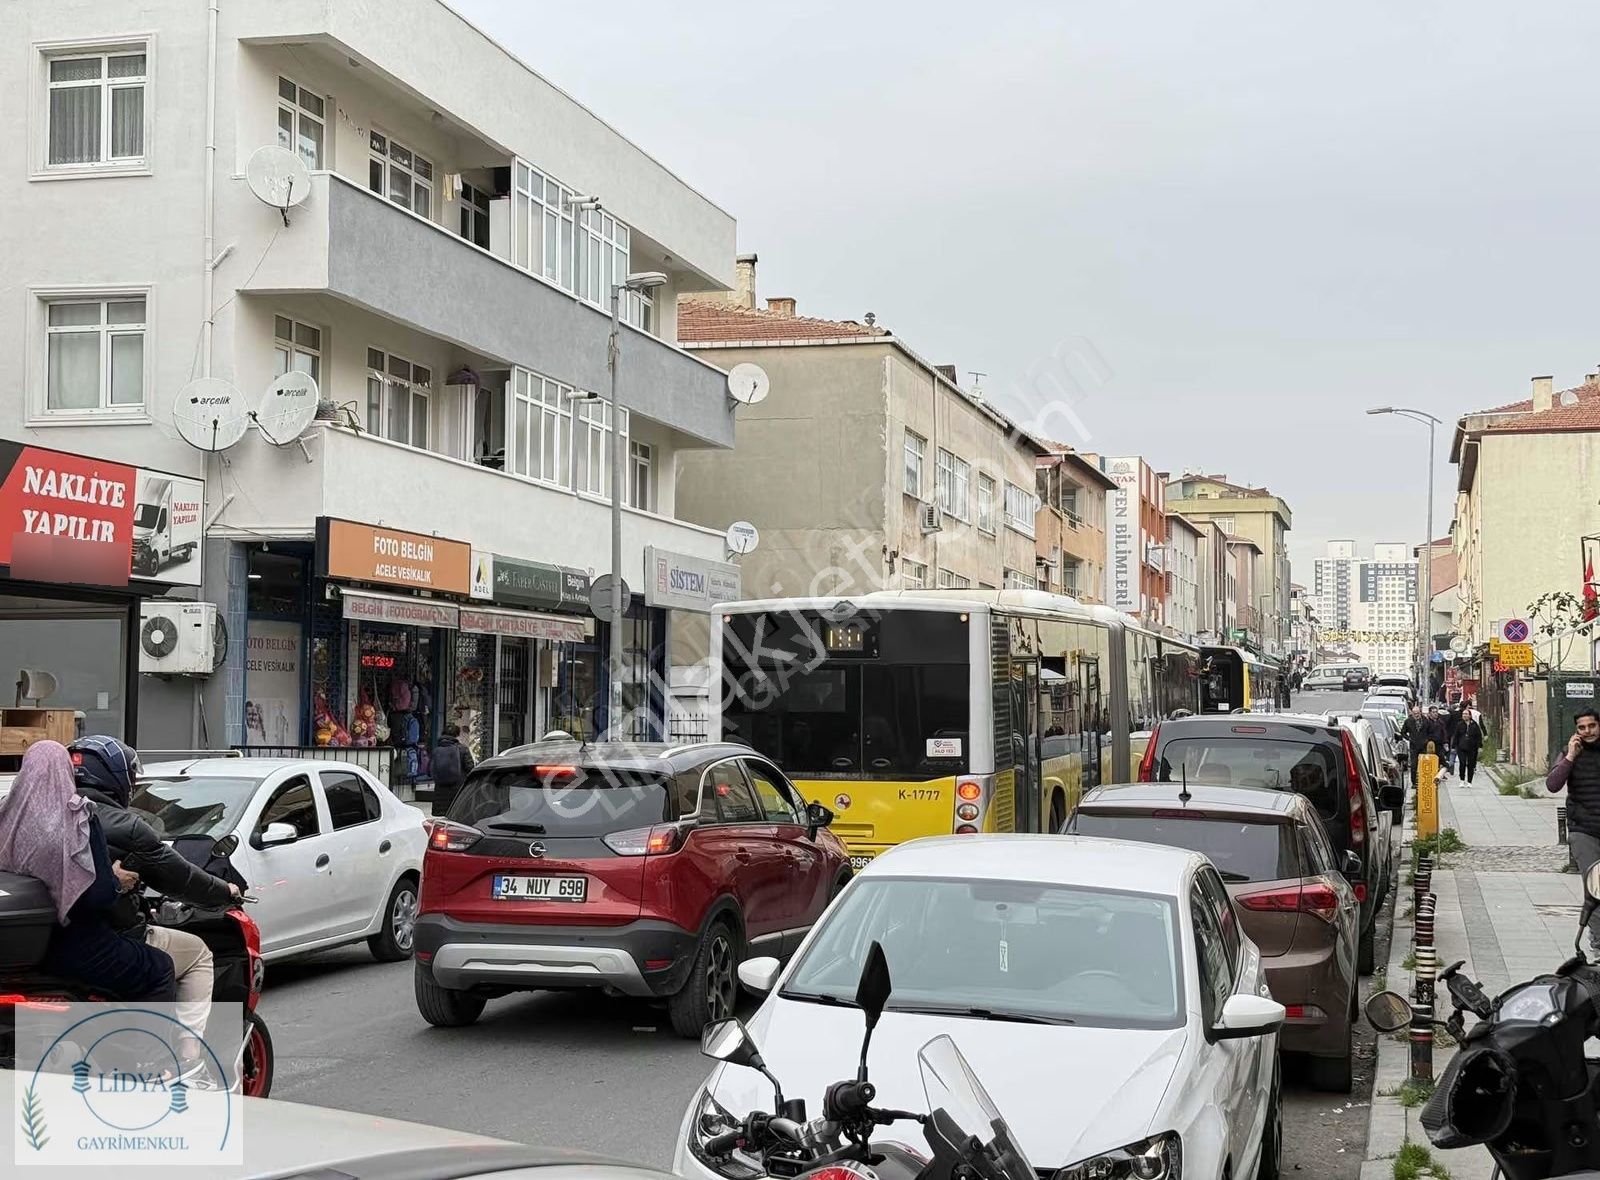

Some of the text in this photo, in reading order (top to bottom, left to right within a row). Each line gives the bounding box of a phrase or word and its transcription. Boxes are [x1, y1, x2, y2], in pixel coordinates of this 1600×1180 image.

[200, 396, 231, 407] arçelik
[23, 466, 126, 508] NAKLİYE
[23, 509, 115, 543] YAPILIR
[374, 536, 434, 562] FOTO BELGİN
[1115, 487, 1133, 605] FEN BİLİMLERİ
[375, 563, 432, 583] ACELE VESİKALIK
[670, 566, 704, 593] SİSTEM
[474, 585, 490, 594] ADEL
[247, 635, 297, 651] OTO BELGİN
[246, 658, 296, 672] CELE VESİKALIK
[898, 789, 940, 800] K-1777
[502, 878, 583, 896] 34 NUY 698
